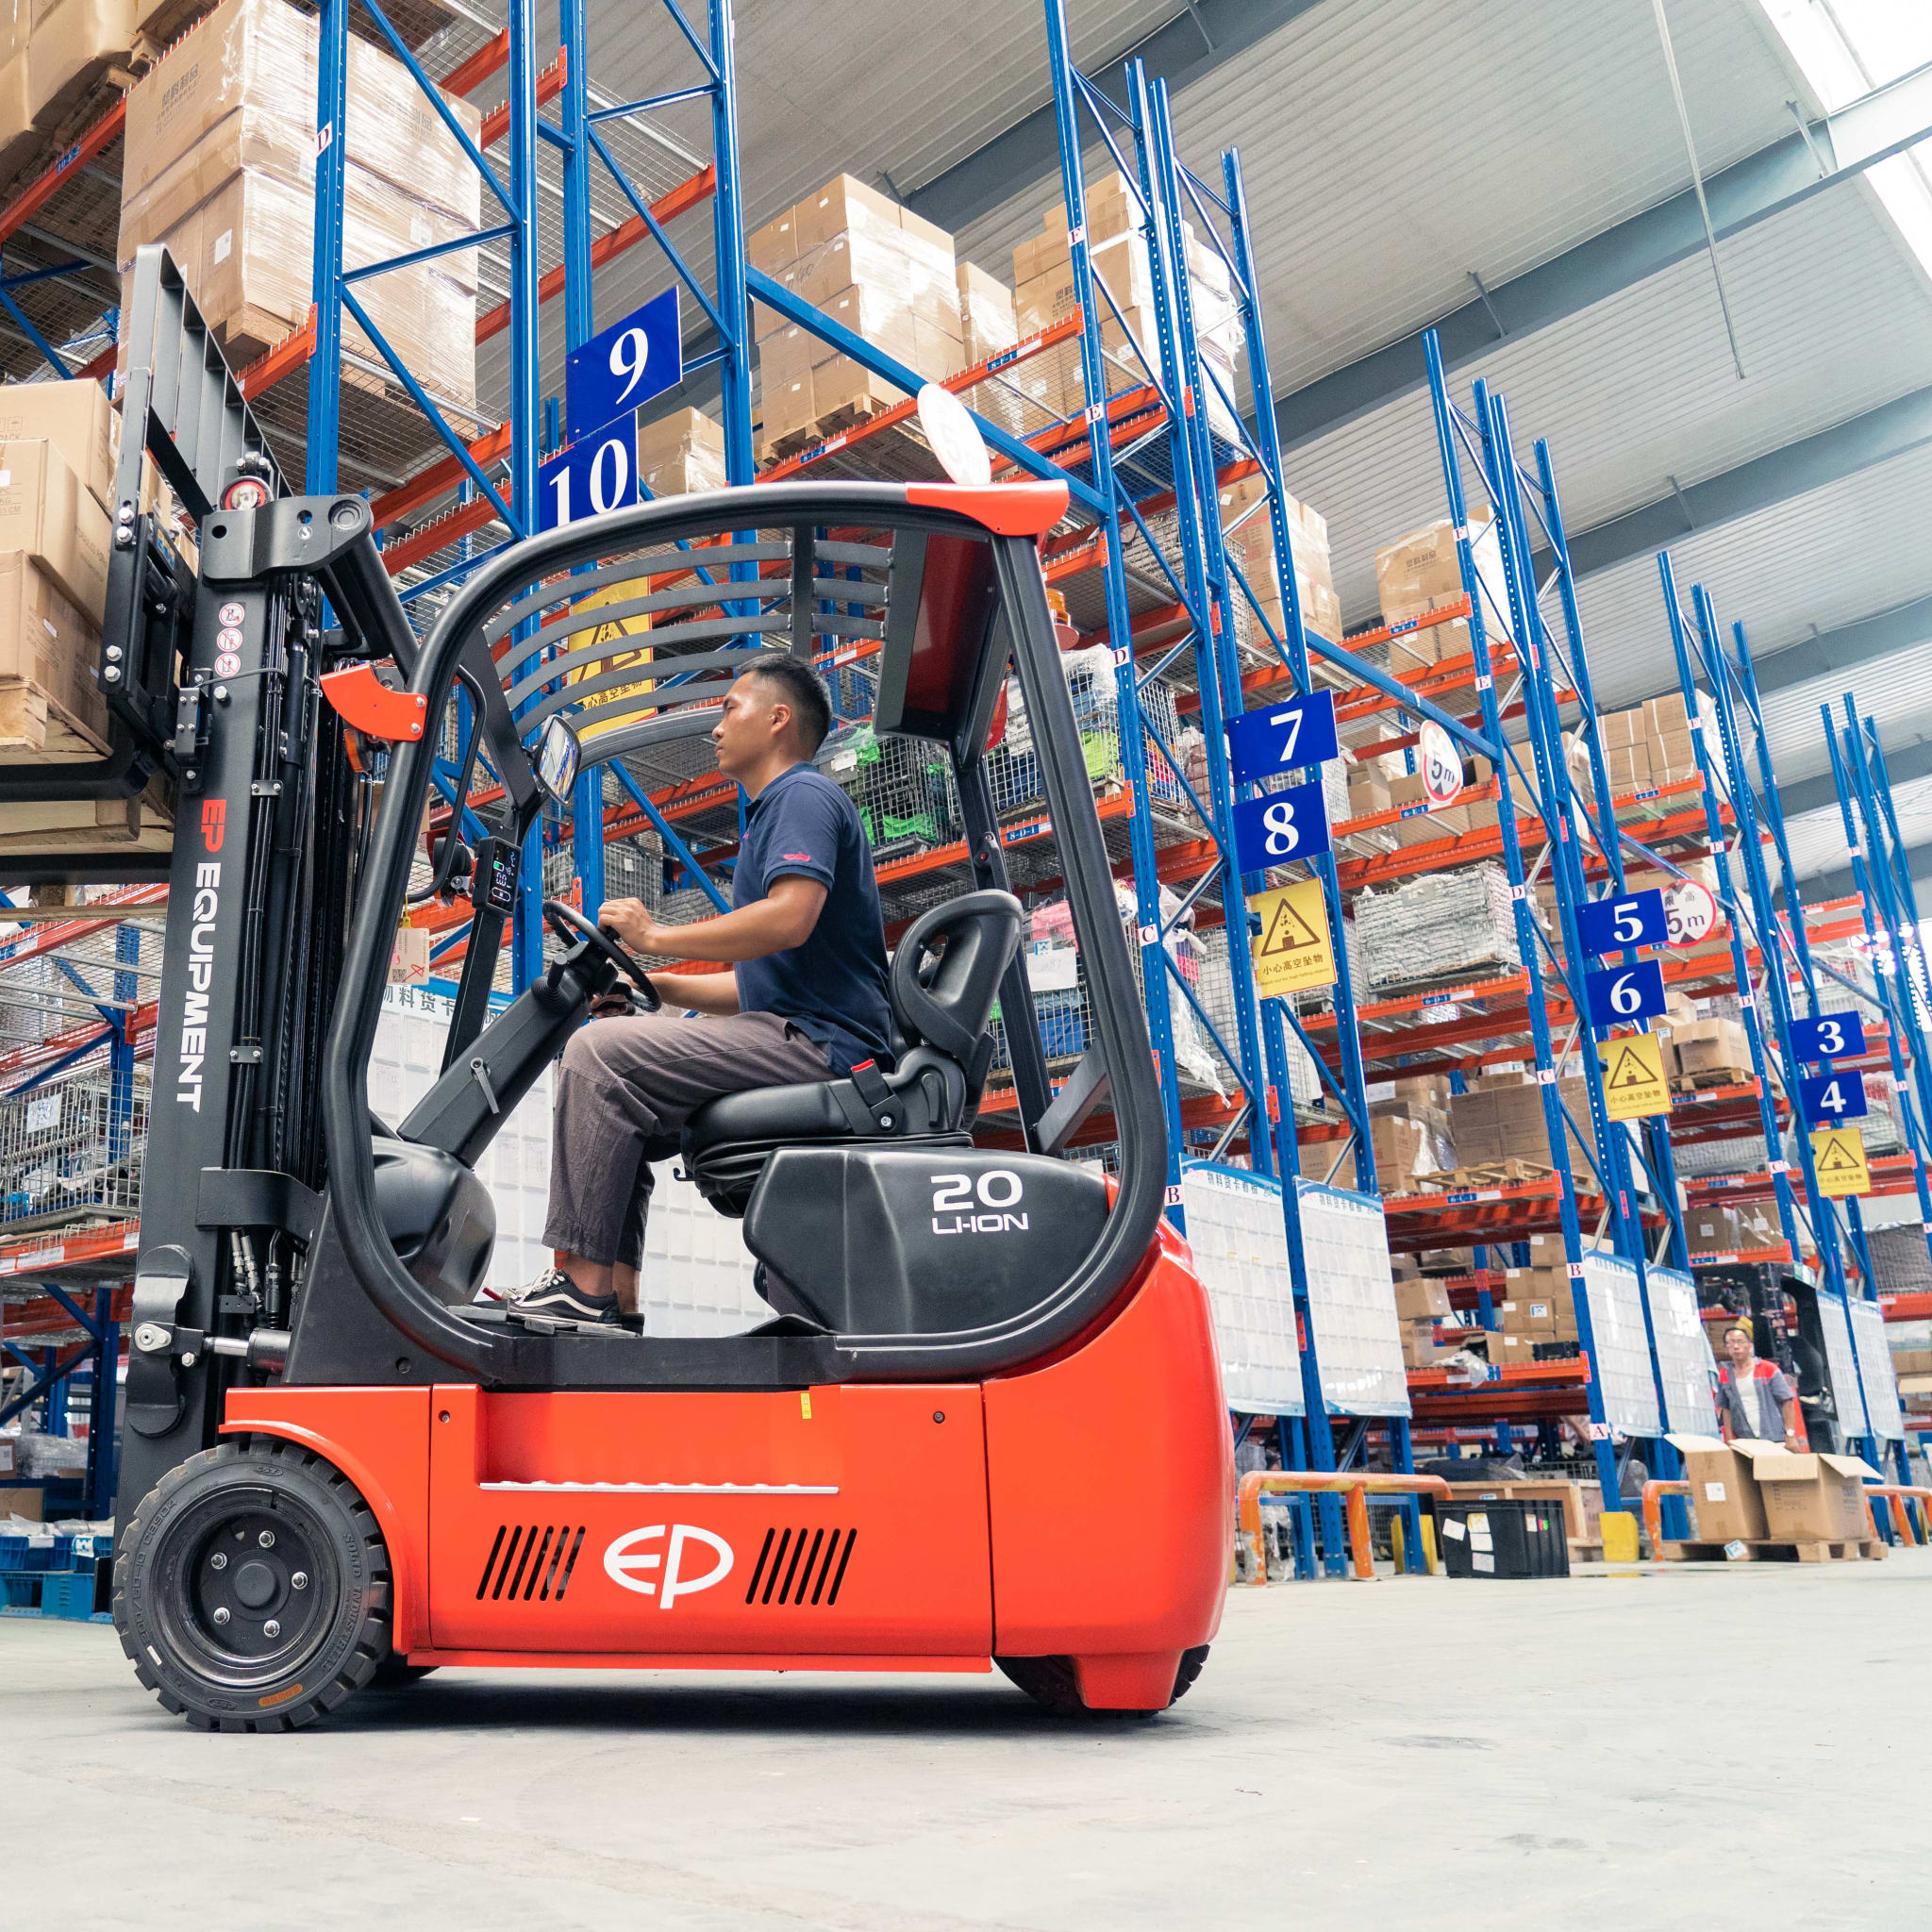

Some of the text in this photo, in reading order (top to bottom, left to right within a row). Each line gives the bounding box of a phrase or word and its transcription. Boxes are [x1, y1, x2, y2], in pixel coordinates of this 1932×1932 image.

[317, 128, 330, 151] D
[1071, 228, 1081, 243] F
[609, 327, 649, 405] 9
[1090, 406, 1102, 422] E
[549, 438, 629, 525] 10
[1455, 527, 1464, 540] F
[1114, 650, 1127, 665] D
[1479, 676, 1490, 688] E
[584, 681, 642, 709] 心高空坠
[1270, 708, 1305, 762] 7
[1009, 825, 1036, 840] 8-D-1
[1263, 801, 1300, 858] 8
[1511, 890, 1522, 900] D
[1612, 902, 1643, 942] 5
[1142, 926, 1157, 942] C
[176, 799, 227, 1113] EP EQUIPMENT
[1262, 953, 1324, 975] 小心高空坠物
[1609, 972, 1642, 1014] 6
[1741, 996, 1751, 1006] D
[1816, 1021, 1845, 1054] 3
[1541, 1070, 1552, 1083] C
[1820, 1080, 1847, 1113] 4
[930, 1170, 1024, 1212] 20
[1167, 1187, 1181, 1204] B
[931, 1212, 1029, 1235] LI-ION
[1571, 1264, 1581, 1276] B
[1593, 1425, 1606, 1438] A
[603, 1524, 735, 1609] EP
